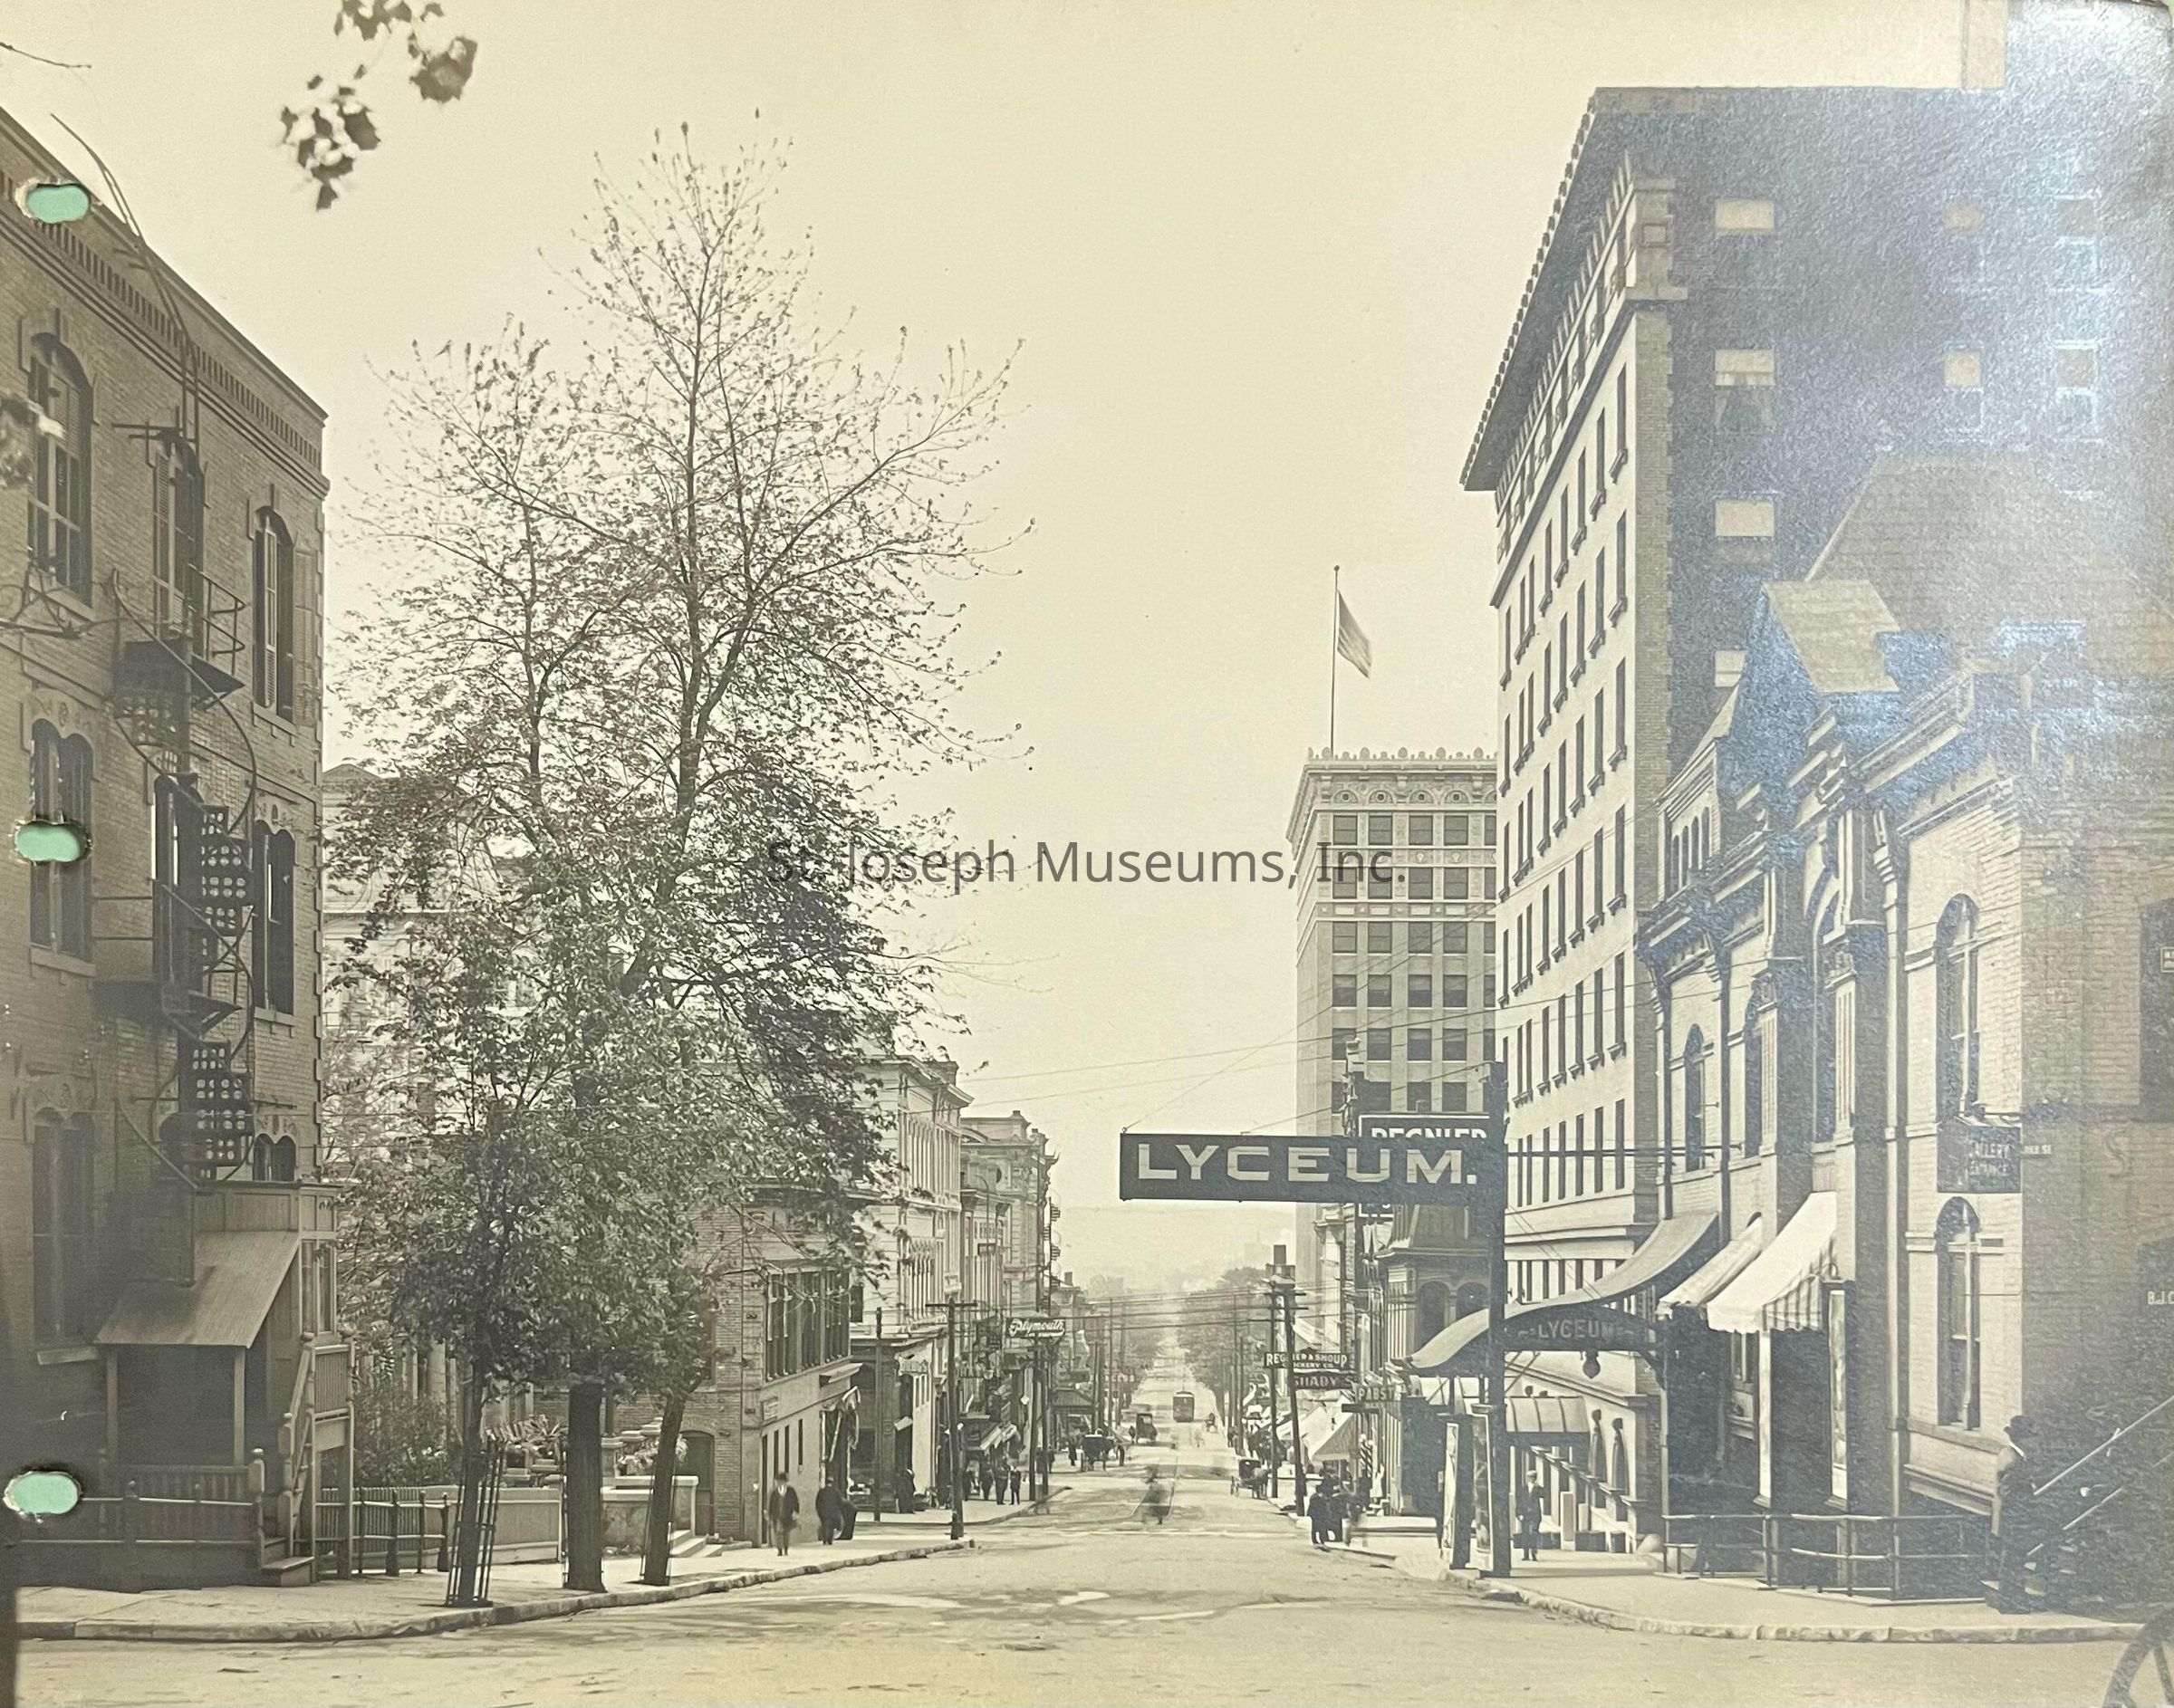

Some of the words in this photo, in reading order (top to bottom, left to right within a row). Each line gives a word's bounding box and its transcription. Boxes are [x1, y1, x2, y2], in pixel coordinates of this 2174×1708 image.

[1138, 1143, 1477, 1185] LYCEUM.
[1008, 1316, 1065, 1338] Plymouth
[1538, 1319, 1614, 1339] LYCEUM
[1358, 1386, 1395, 1401] PABST
